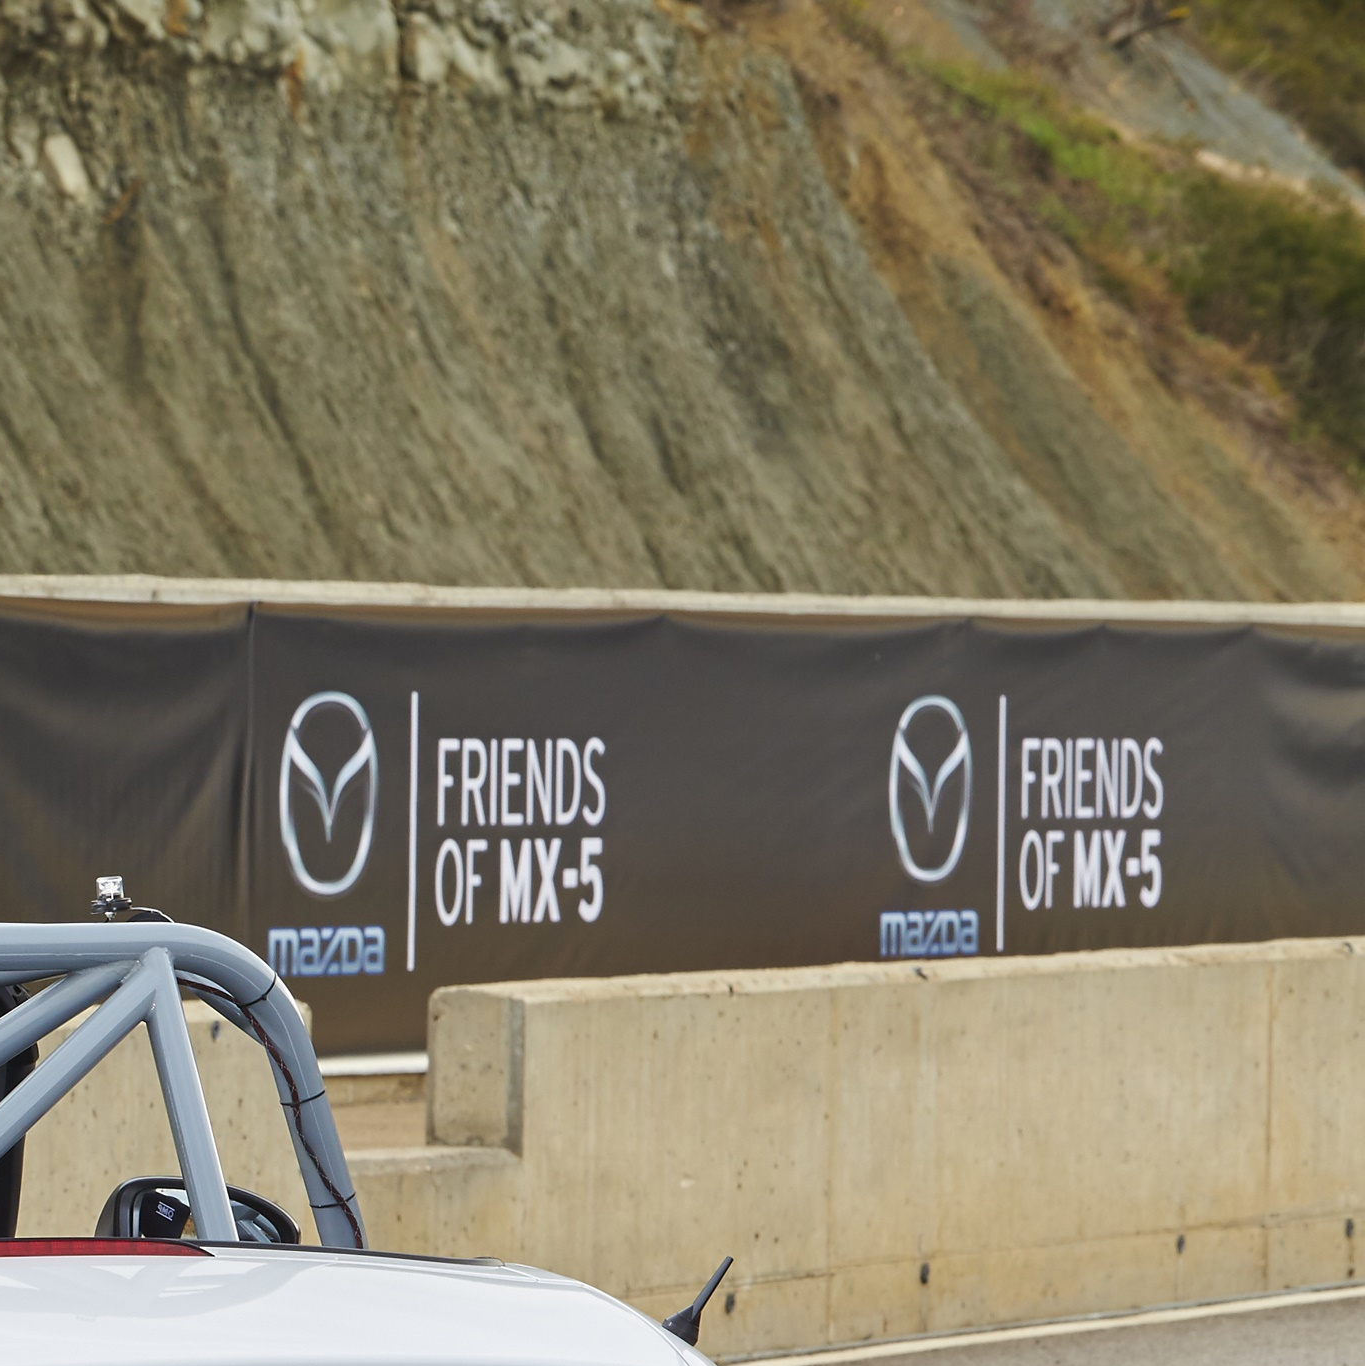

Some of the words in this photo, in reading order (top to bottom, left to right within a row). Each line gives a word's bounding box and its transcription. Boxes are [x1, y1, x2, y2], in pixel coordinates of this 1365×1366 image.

[437, 736, 607, 827] FRIENDS
[1021, 736, 1165, 820] FRIENDS
[435, 838, 489, 927] OF
[498, 836, 605, 924] MX-5
[1018, 829, 1065, 911] OF
[1073, 828, 1163, 909] MX-5
